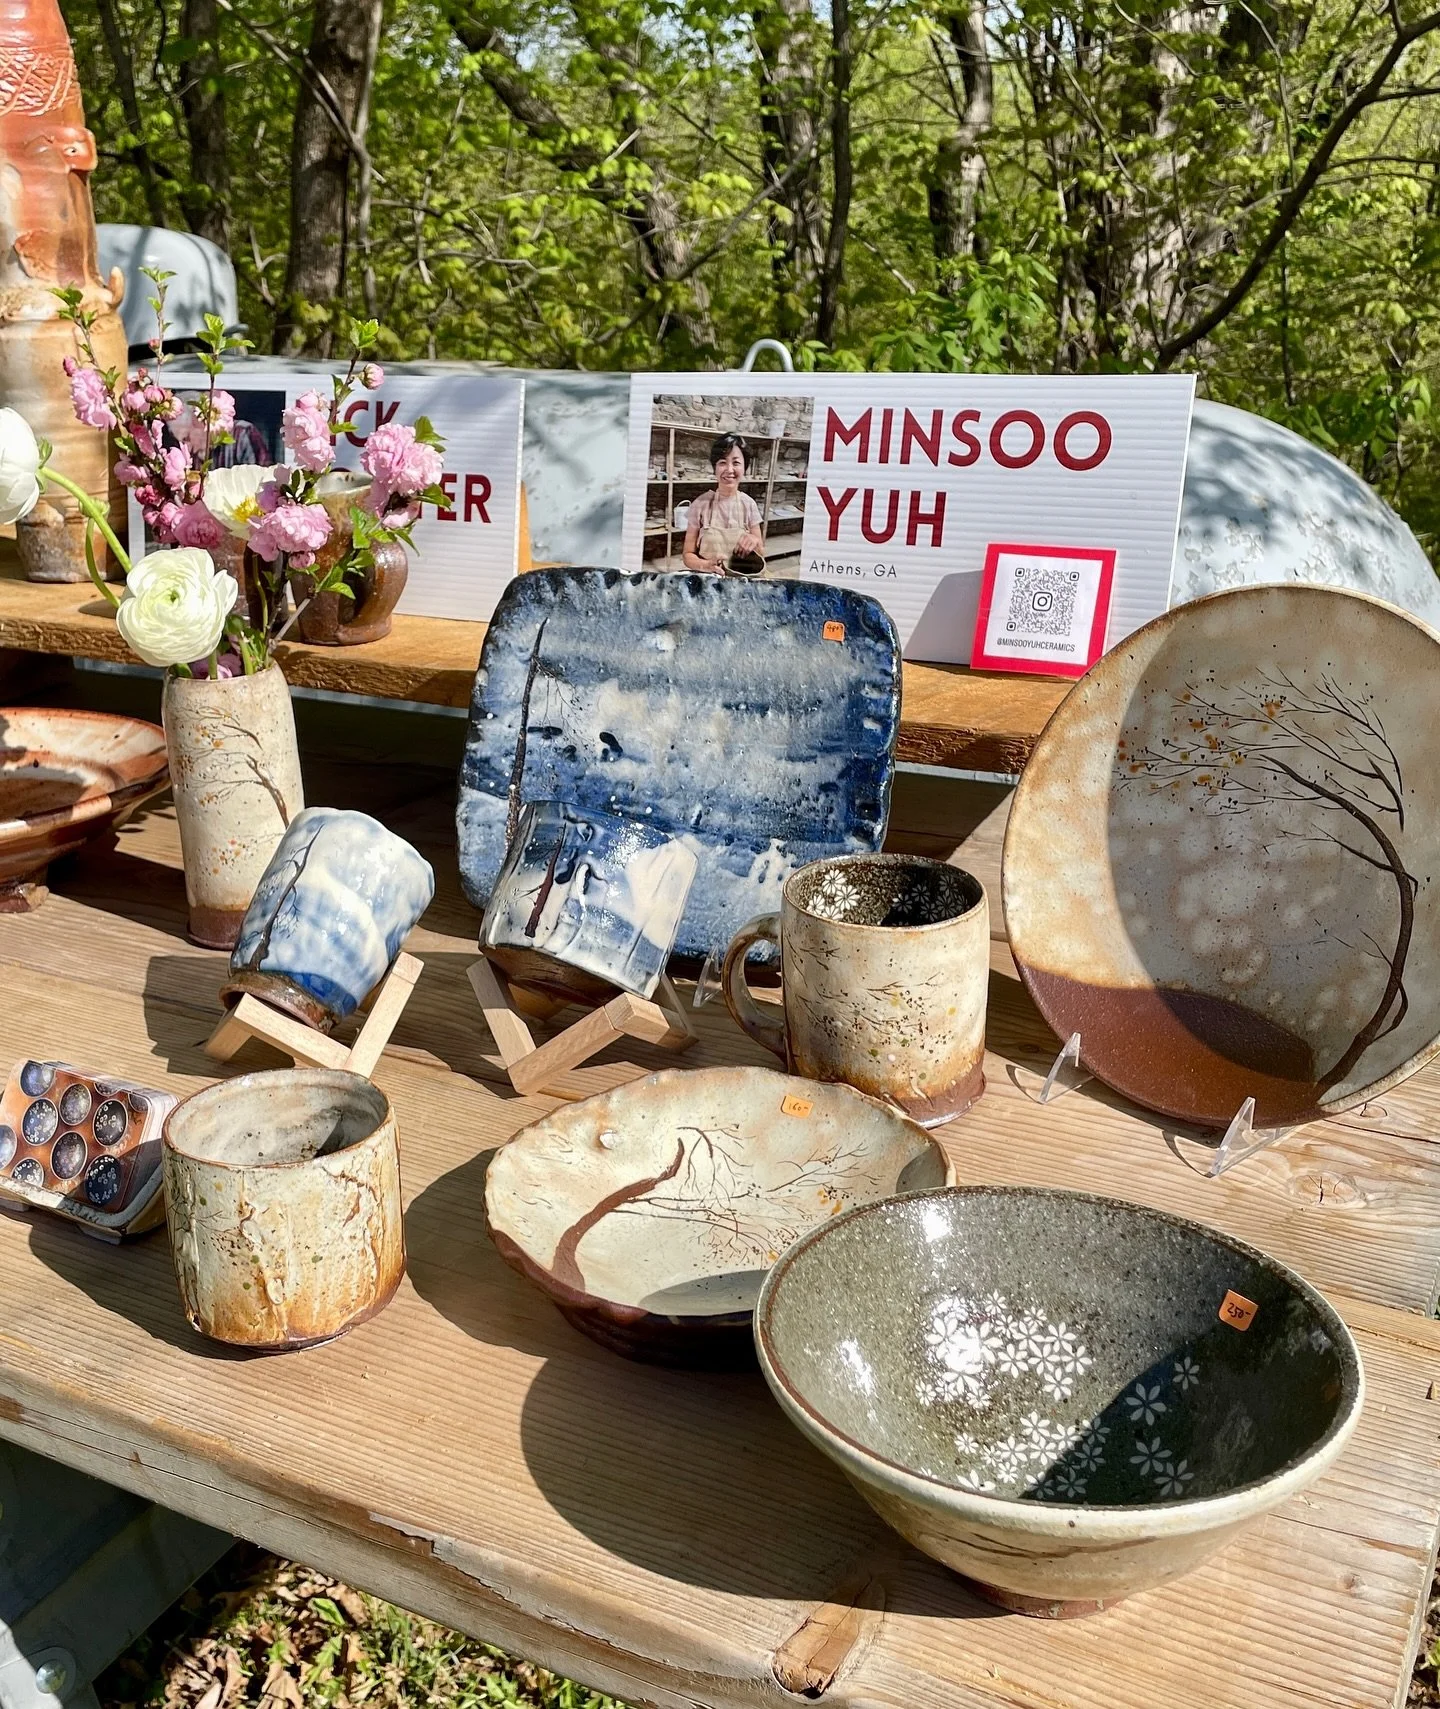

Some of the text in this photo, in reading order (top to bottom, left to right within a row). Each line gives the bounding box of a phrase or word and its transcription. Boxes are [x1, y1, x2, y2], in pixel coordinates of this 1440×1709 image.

[296, 398, 401, 448] ICK
[823, 406, 1112, 471] MINSOO
[816, 486, 947, 548] YUH
[809, 559, 897, 578] Athens, GA
[996, 637, 1076, 652] @MINSOOYUHCERAMICS
